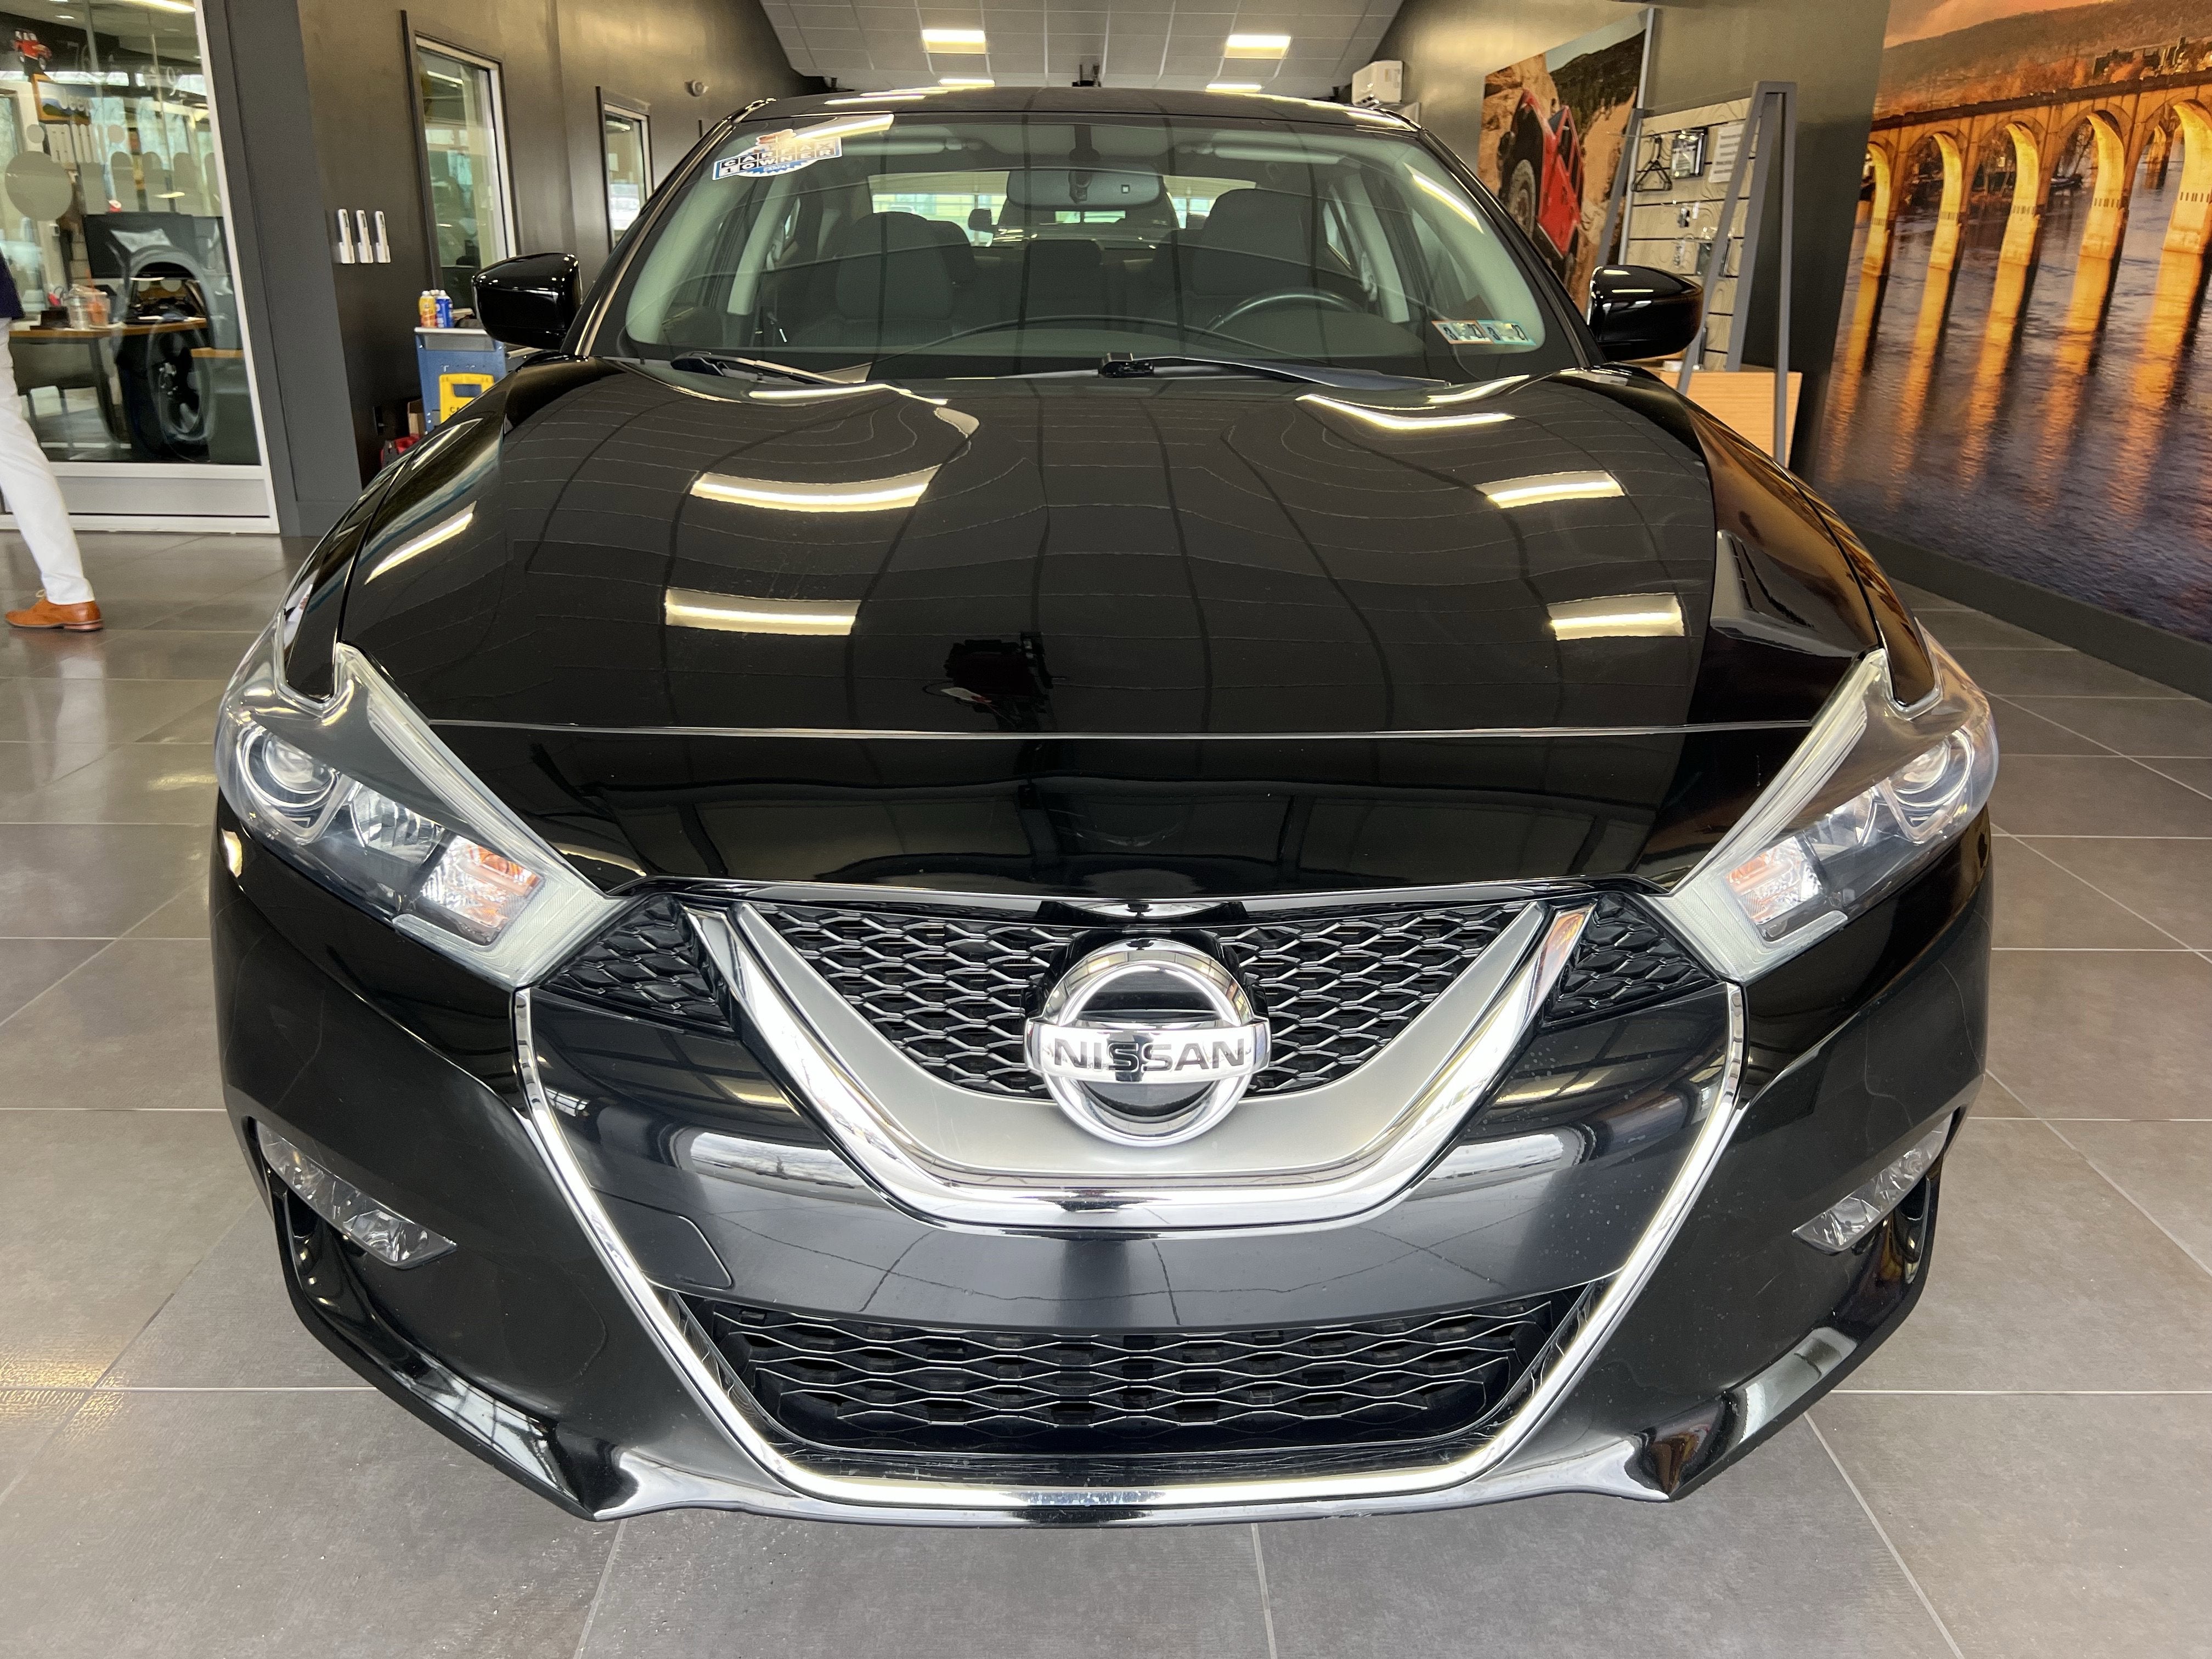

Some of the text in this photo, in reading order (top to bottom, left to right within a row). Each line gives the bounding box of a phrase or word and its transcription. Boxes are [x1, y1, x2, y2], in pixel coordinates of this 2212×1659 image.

[724, 142, 832, 167] CARFAX
[742, 149, 831, 170] OWNER
[1054, 1038, 1244, 1071] NISSAN
